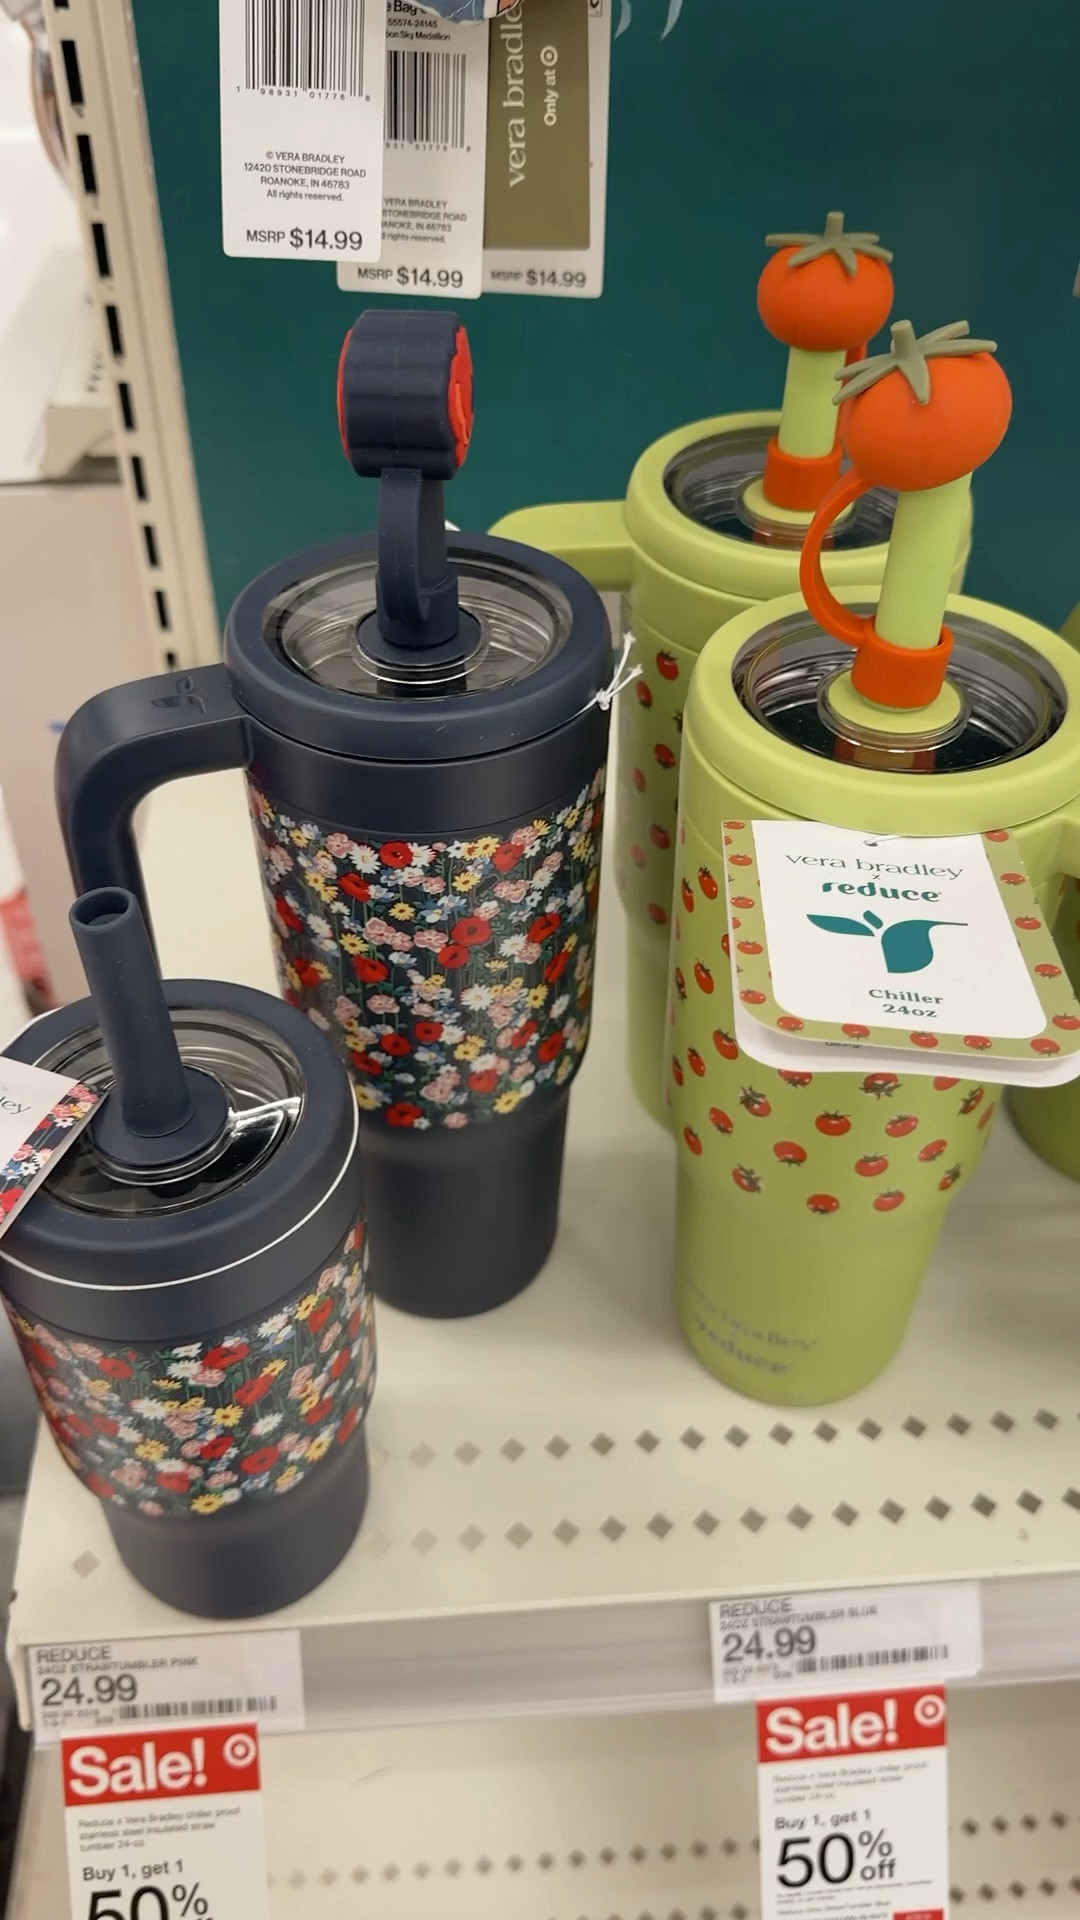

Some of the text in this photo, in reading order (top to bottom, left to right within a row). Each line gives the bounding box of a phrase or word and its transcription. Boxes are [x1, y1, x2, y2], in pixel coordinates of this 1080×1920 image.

[500, 3, 527, 187] vera bradle
[544, 69, 560, 127] Only at
[275, 151, 300, 161] VERA
[301, 153, 346, 164] BRADLEY
[244, 162, 367, 178] 12420 STONEBRIDGE ROAD
[260, 176, 350, 190] ROANOKE, IN 46783
[266, 189, 277, 199] All
[278, 190, 303, 201] rights
[408, 199, 448, 209] BRADLEY
[443, 213, 467, 221] ROAD
[246, 227, 363, 251] MSRP $14.99
[357, 266, 464, 289] MSRP $14.99
[525, 269, 587, 289] $14.99
[785, 855, 963, 881] vera bradley
[821, 881, 941, 903] reduce
[868, 988, 944, 1005] Chiller
[882, 1003, 938, 1018] 24oz
[720, 1597, 793, 1620] REDUCE
[36, 1644, 112, 1664] REDUCE
[722, 1625, 817, 1664] 24.99
[41, 1673, 138, 1708] 24.99
[765, 1697, 899, 1756] Sale!
[69, 1738, 208, 1798] Sale!
[774, 1816, 807, 1831] Buy
[830, 1810, 858, 1827] get
[864, 1808, 872, 1821] 1
[82, 1865, 117, 1882] Buy
[141, 1860, 170, 1879] get
[175, 1858, 185, 1874] 1
[860, 1858, 897, 1881] off
